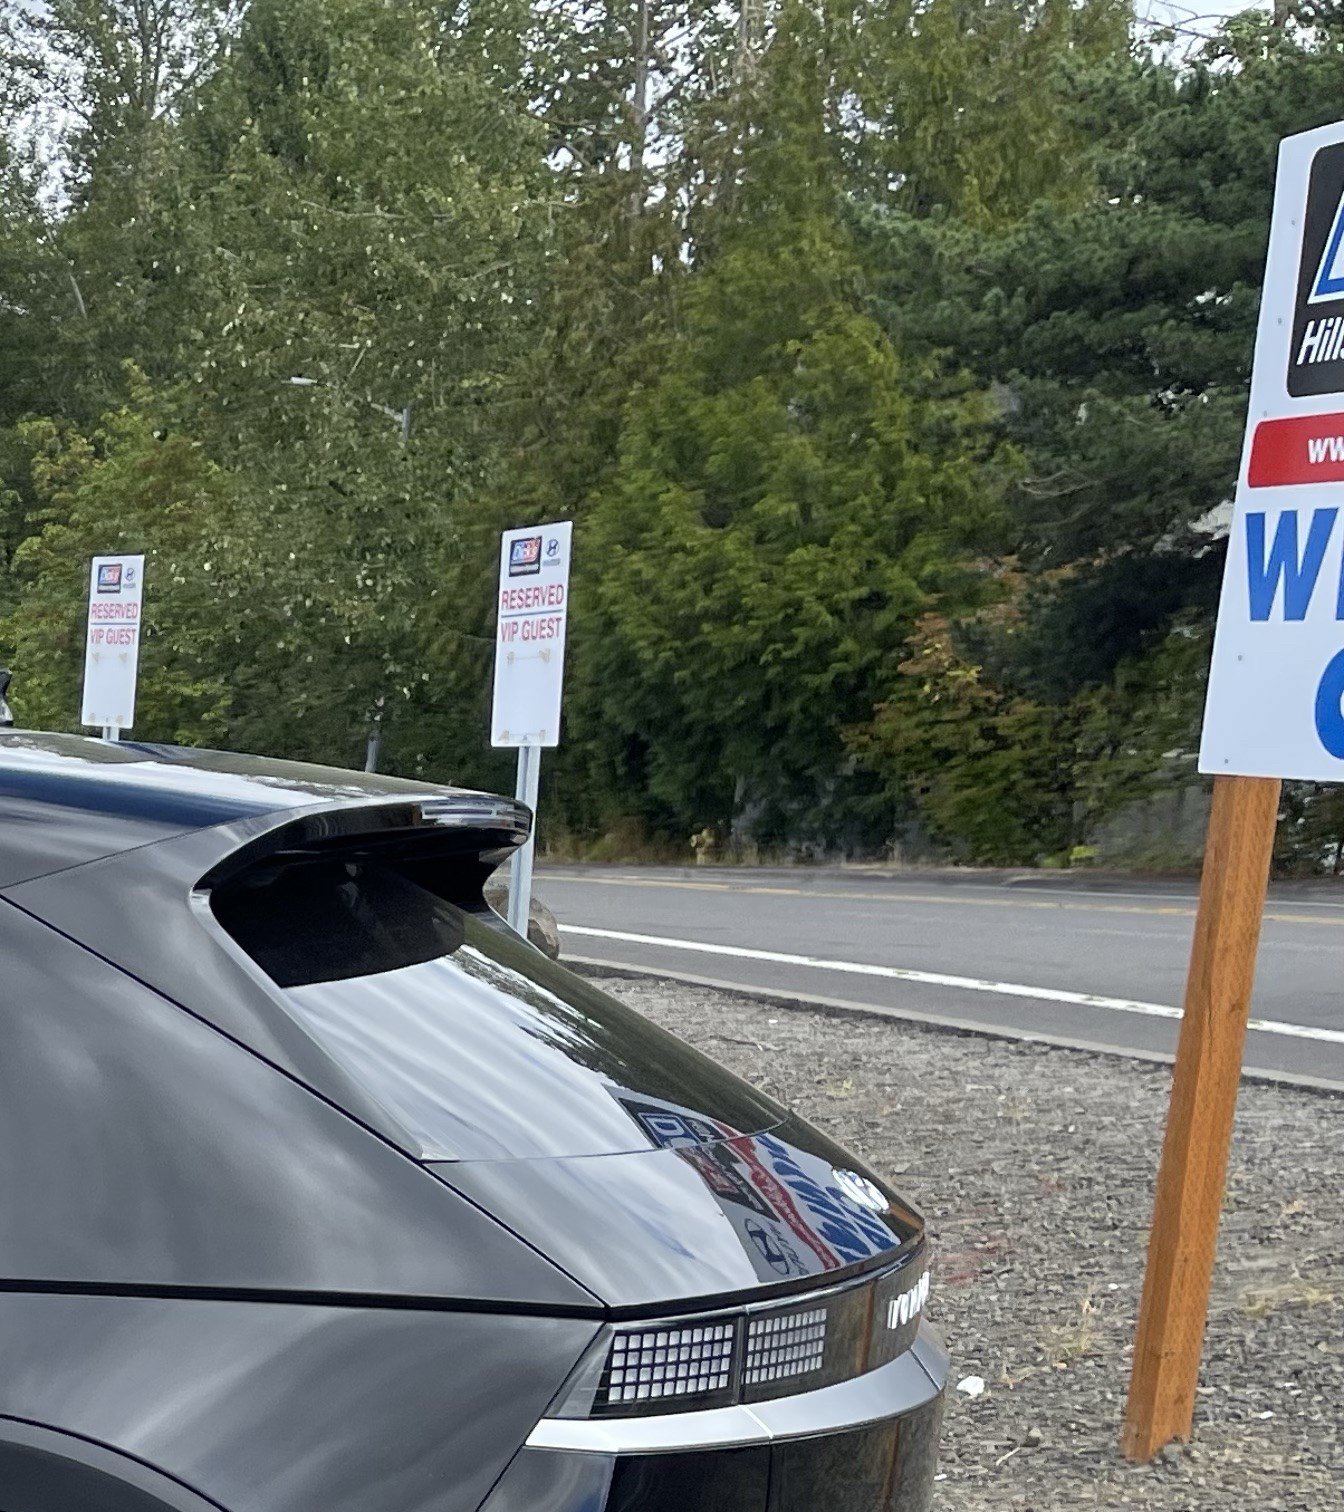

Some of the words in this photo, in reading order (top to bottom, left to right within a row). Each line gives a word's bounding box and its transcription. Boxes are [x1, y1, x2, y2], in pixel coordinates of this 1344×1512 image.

[1296, 316, 1344, 365] Hill
[1245, 507, 1344, 622] W
[501, 584, 565, 610] RESERVED
[91, 602, 139, 620] RESERVED
[106, 627, 137, 645] GUEST
[501, 619, 519, 642] VIP
[521, 617, 563, 641] GUEST
